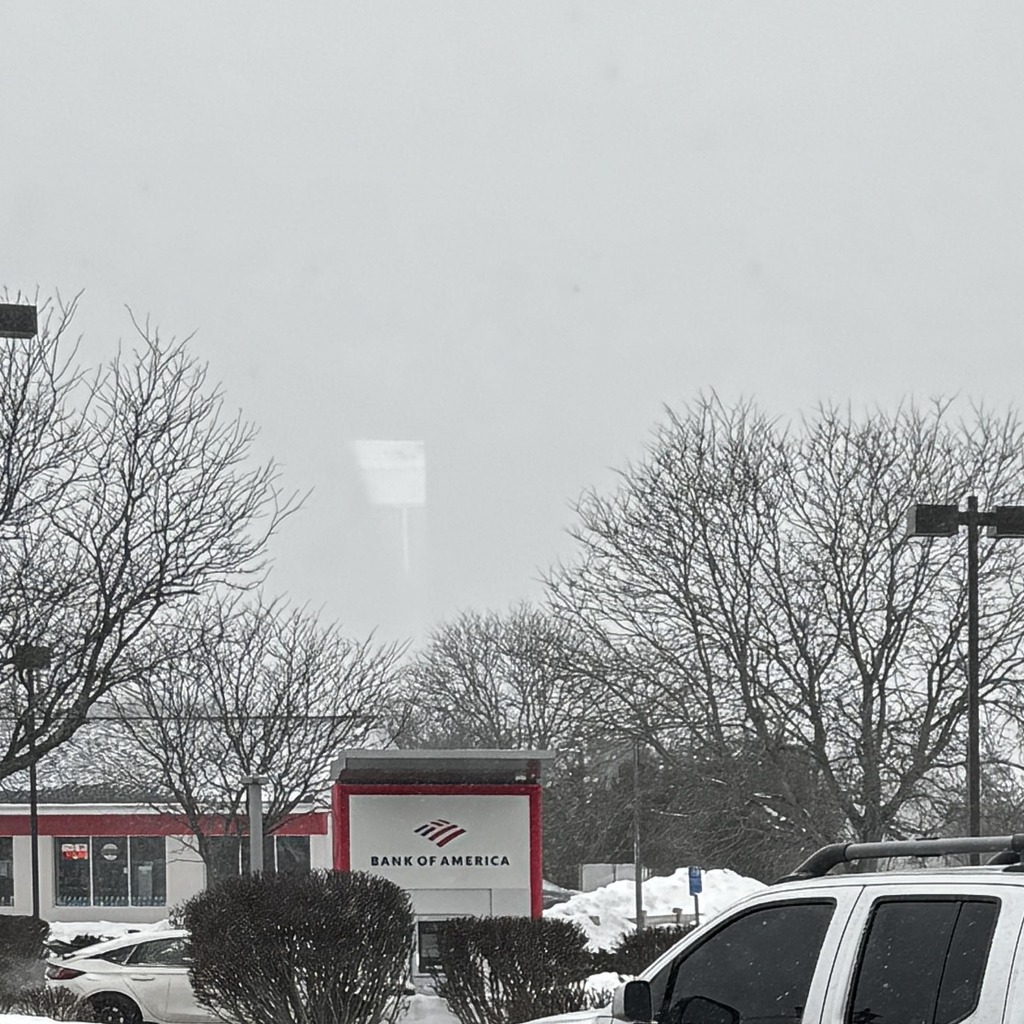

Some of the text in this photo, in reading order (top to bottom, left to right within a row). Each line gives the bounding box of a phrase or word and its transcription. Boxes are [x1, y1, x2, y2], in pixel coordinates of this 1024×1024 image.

[371, 856, 510, 866] BANK OF AMERICA
